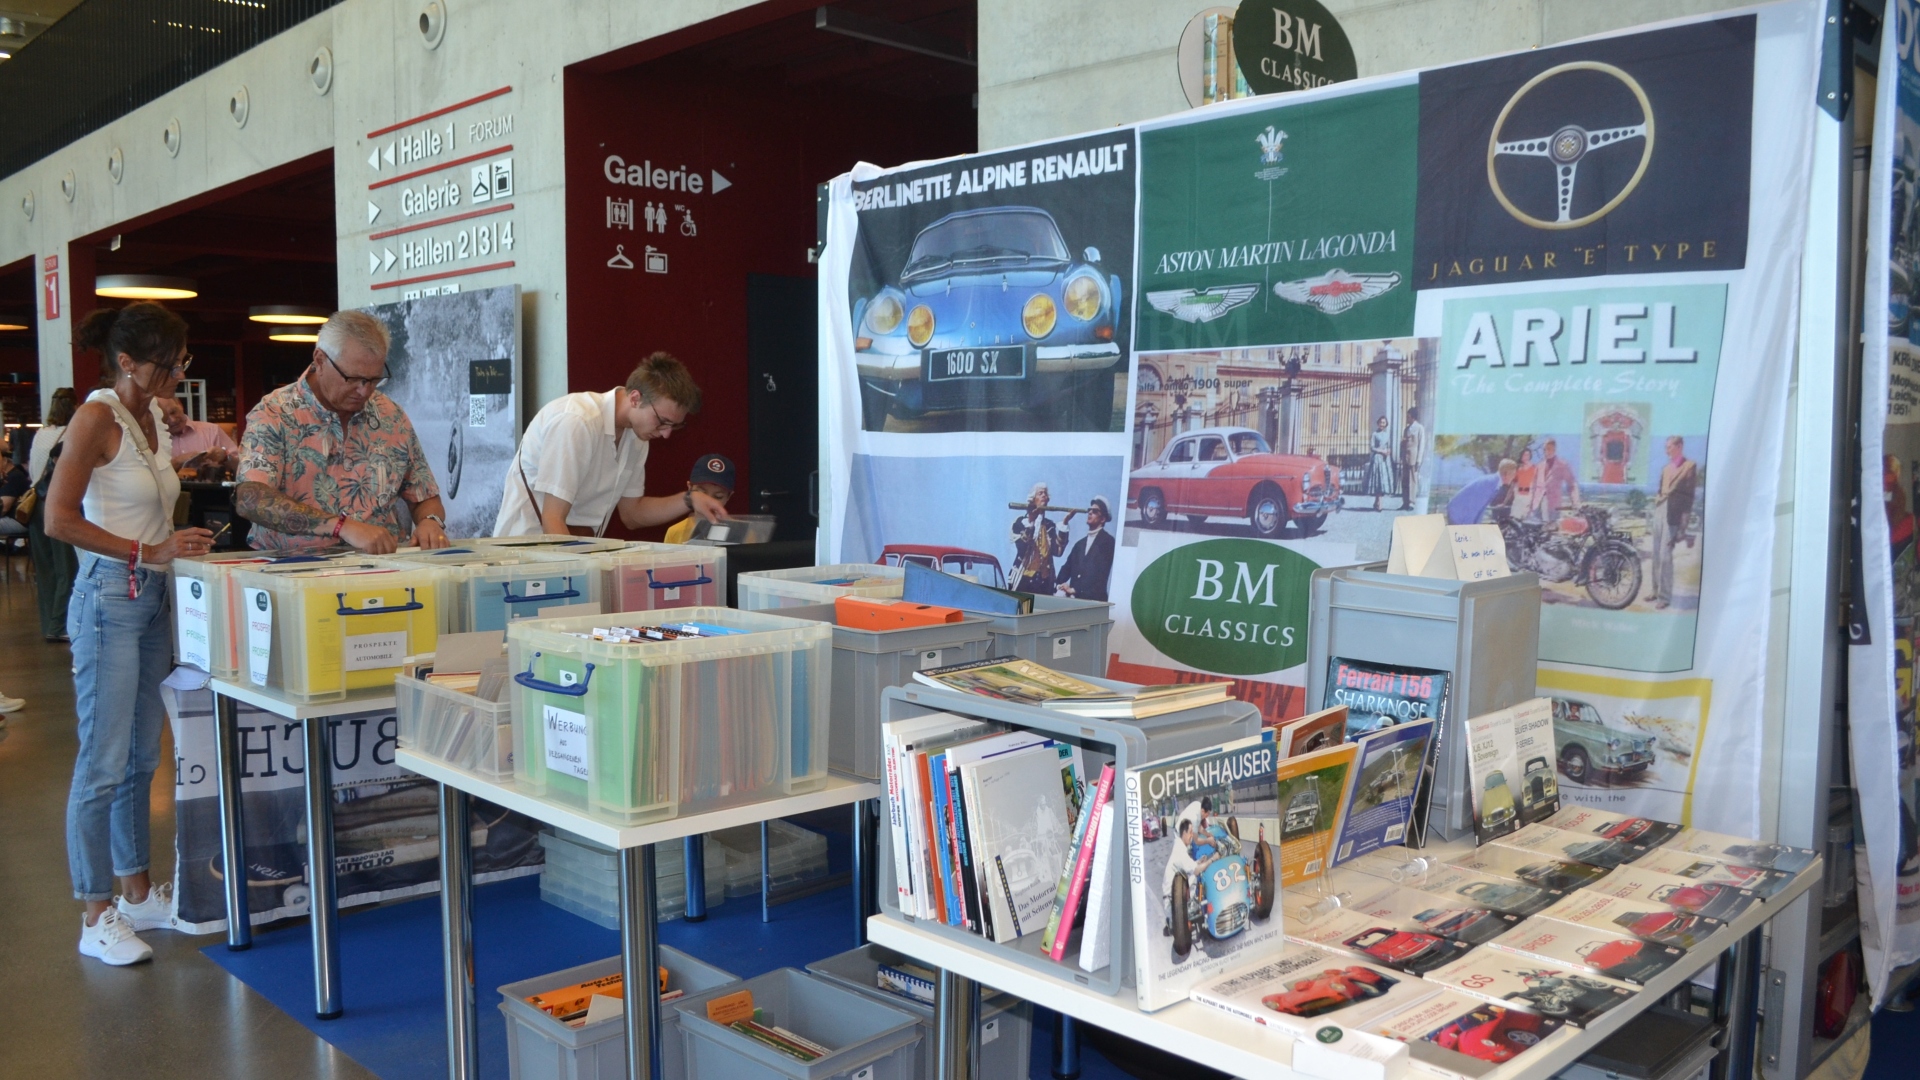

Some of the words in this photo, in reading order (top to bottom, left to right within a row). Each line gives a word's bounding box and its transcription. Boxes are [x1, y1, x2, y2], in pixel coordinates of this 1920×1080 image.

[1272, 7, 1324, 62] BM
[400, 129, 443, 165] Halle
[446, 122, 456, 150] 1
[469, 114, 514, 143] FORUM
[603, 154, 704, 194] Galerie
[853, 172, 952, 211] BERLINETTE
[956, 160, 1027, 196] ALPINE
[1032, 143, 1128, 185] RENAULT
[401, 178, 461, 218] Galerie
[402, 235, 455, 270] Hallen
[1155, 249, 1215, 275] ASTON
[1218, 240, 1296, 268] MARTIN
[1299, 229, 1397, 262] LAGONDA
[1429, 252, 1557, 281] JAGUAR
[1624, 241, 1717, 262] TYPE
[1454, 301, 1698, 370] ARIEL
[947, 351, 975, 375] 1600
[981, 350, 999, 374] SX
[1138, 381, 1155, 392] alfa
[1192, 377, 1220, 390] 1900
[1223, 378, 1253, 391] super
[1453, 373, 1496, 395] The
[1505, 373, 1603, 399] Complete
[1608, 369, 1681, 395] Story
[1190, 558, 1280, 607] BM
[354, 640, 398, 649] PROSPEKTE
[1164, 614, 1295, 647] CLASSICS
[356, 653, 393, 662] AUTOMOBILE
[1337, 664, 1396, 694] Ferrari
[1400, 674, 1432, 699] 156
[1334, 688, 1427, 719] SHARKNOSE
[1515, 724, 1529, 736] SILVER
[1529, 718, 1550, 730] SHADOW
[887, 757, 896, 795] Motorräder
[1149, 748, 1271, 800] OFFENHAUSER
[889, 797, 897, 826] Jahrbuch
[1096, 780, 1108, 810] FERRARI
[1574, 791, 1602, 803] with
[1608, 792, 1626, 803] the
[1085, 810, 1102, 849] TURBOS
[1126, 776, 1142, 885] OFFENHAUSER
[1063, 846, 1076, 879] Ferraris
[1212, 862, 1246, 891] 82
[1018, 901, 1029, 912] Das
[1029, 882, 1057, 904] Motorrad
[1021, 912, 1031, 923] mit
[1167, 962, 1192, 978] LEGENDARY
[1243, 940, 1253, 949] MEN
[1461, 974, 1495, 989] GS
